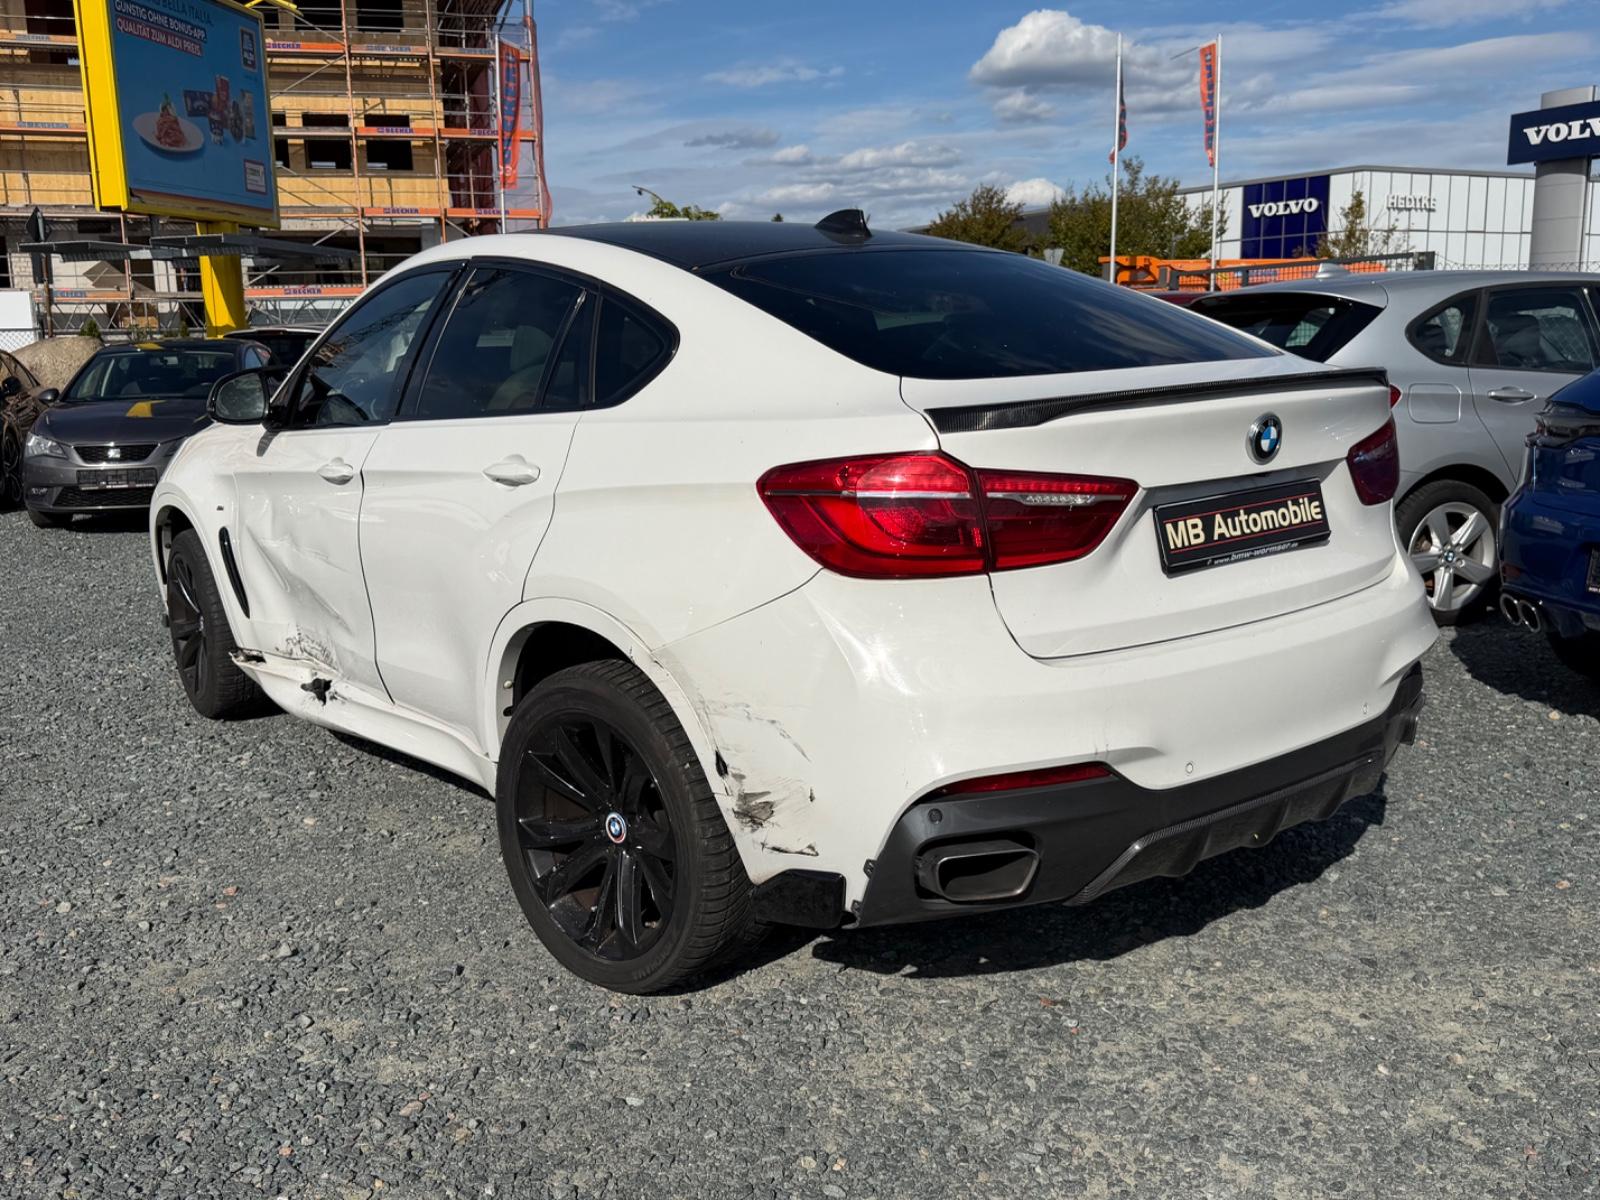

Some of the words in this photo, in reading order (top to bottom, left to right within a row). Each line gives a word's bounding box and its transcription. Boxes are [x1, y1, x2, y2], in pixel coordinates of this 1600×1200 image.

[148, 10, 169, 27] OHNE
[151, 28, 167, 44] ZUM
[167, 35, 182, 50] ALDI
[1248, 198, 1319, 218] VOLVO
[1386, 193, 1436, 212] HEDTKE
[1165, 518, 1205, 549] MB
[1213, 497, 1322, 540] Automobile
